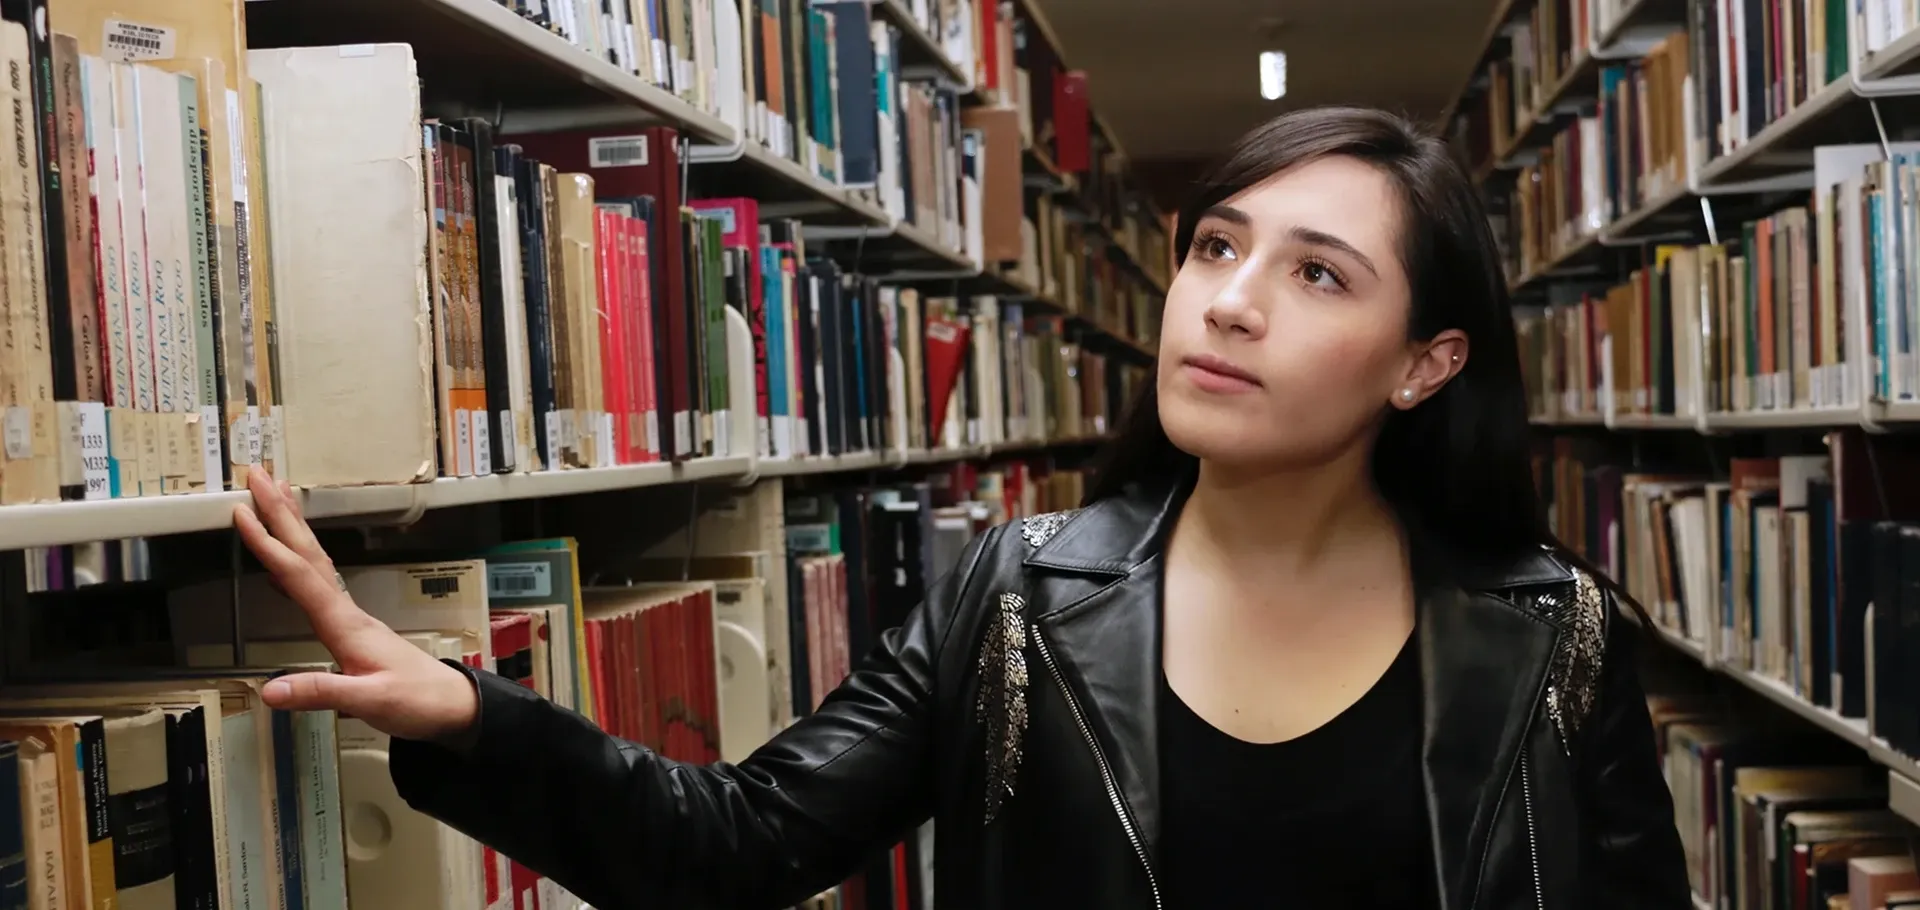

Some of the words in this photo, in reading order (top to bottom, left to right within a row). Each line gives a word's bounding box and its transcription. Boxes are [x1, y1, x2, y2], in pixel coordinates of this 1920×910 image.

[9, 59, 20, 91] ROO
[13, 97, 28, 169] QUINTANA
[188, 105, 196, 124] La
[194, 207, 203, 227] de
[196, 231, 205, 255] los
[209, 247, 219, 299] QUINTANA
[198, 260, 208, 328] letrados
[82, 314, 91, 360] Carlos
[112, 303, 129, 408] QUINTANA
[135, 307, 150, 411] QUINTANA
[178, 312, 193, 412] QUINTANA
[82, 435, 102, 449] 1333
[84, 456, 109, 470] M332
[85, 478, 106, 492] 1997
